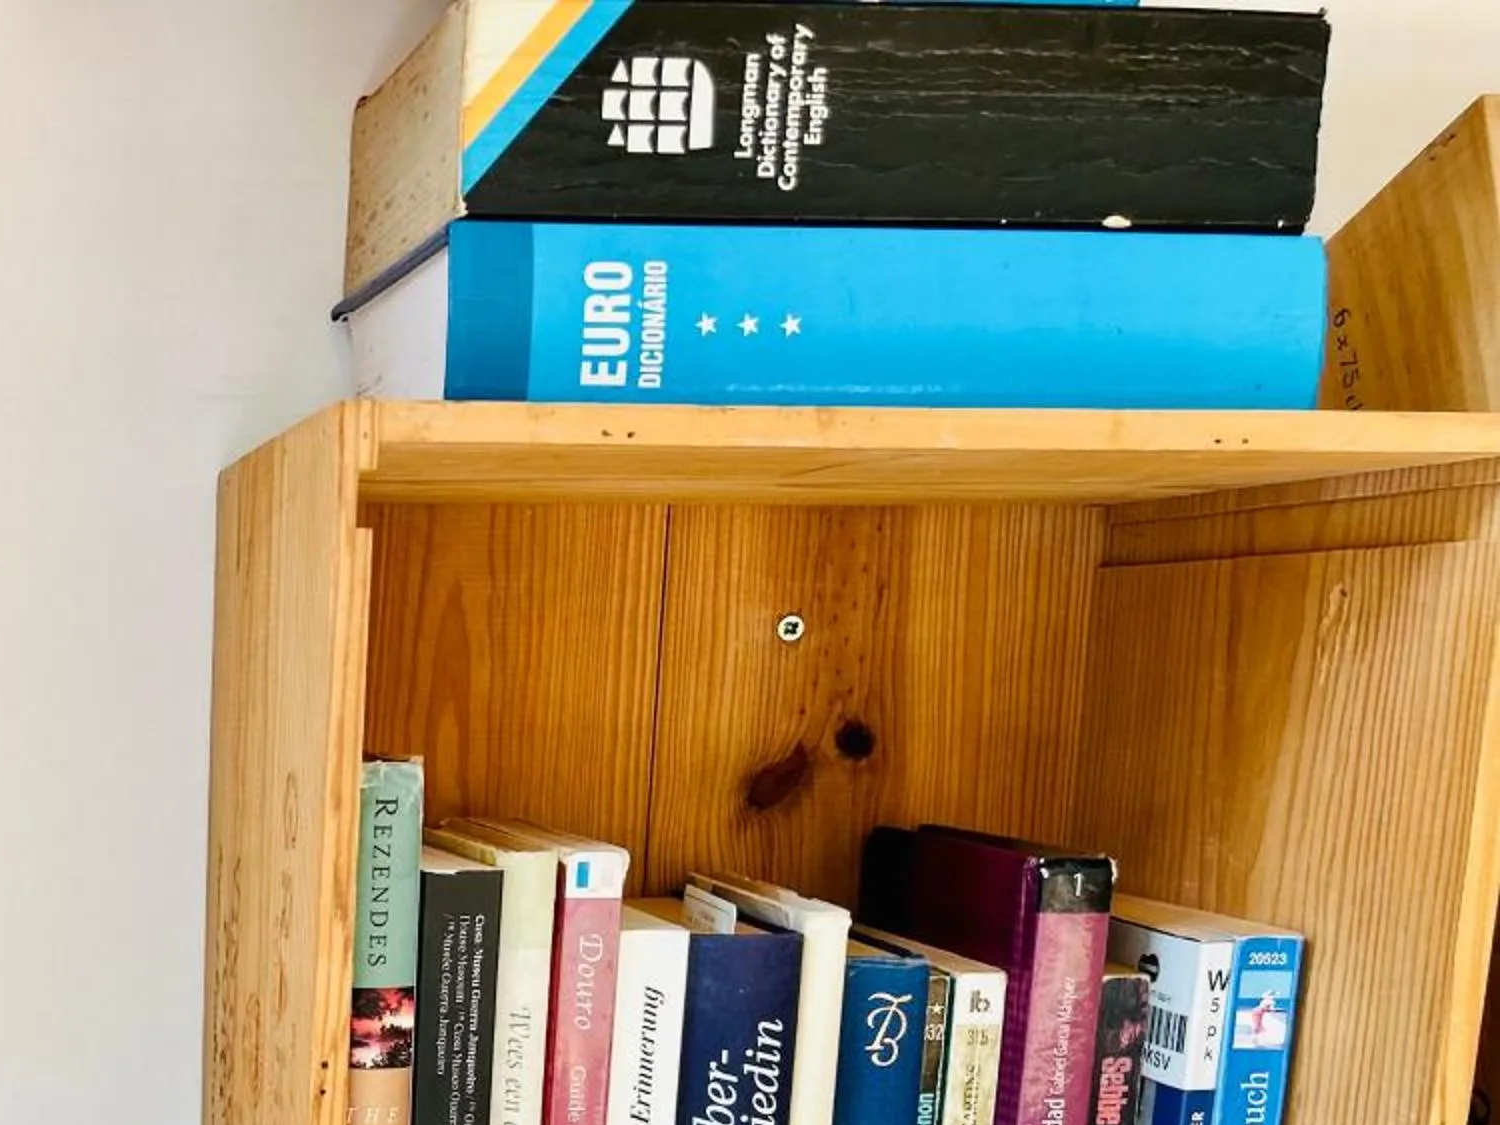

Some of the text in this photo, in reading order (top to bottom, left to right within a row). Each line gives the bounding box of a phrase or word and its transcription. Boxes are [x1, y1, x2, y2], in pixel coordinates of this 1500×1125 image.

[734, 52, 762, 159] Longman
[757, 33, 787, 179] Dictionary of
[777, 23, 816, 192] Contemporary
[802, 66, 828, 147] English
[580, 260, 634, 388] EURO
[637, 260, 668, 389] DICIONÁRIO
[367, 797, 399, 969] REZENDES
[1073, 871, 1083, 896] 1
[469, 989, 482, 1031] Guerra
[576, 933, 603, 1031] Douro
[463, 1034, 480, 1094] Junqueiro
[505, 1006, 532, 1070] Wees
[634, 985, 667, 1119] Erinnerung
[505, 1078, 523, 1114] een
